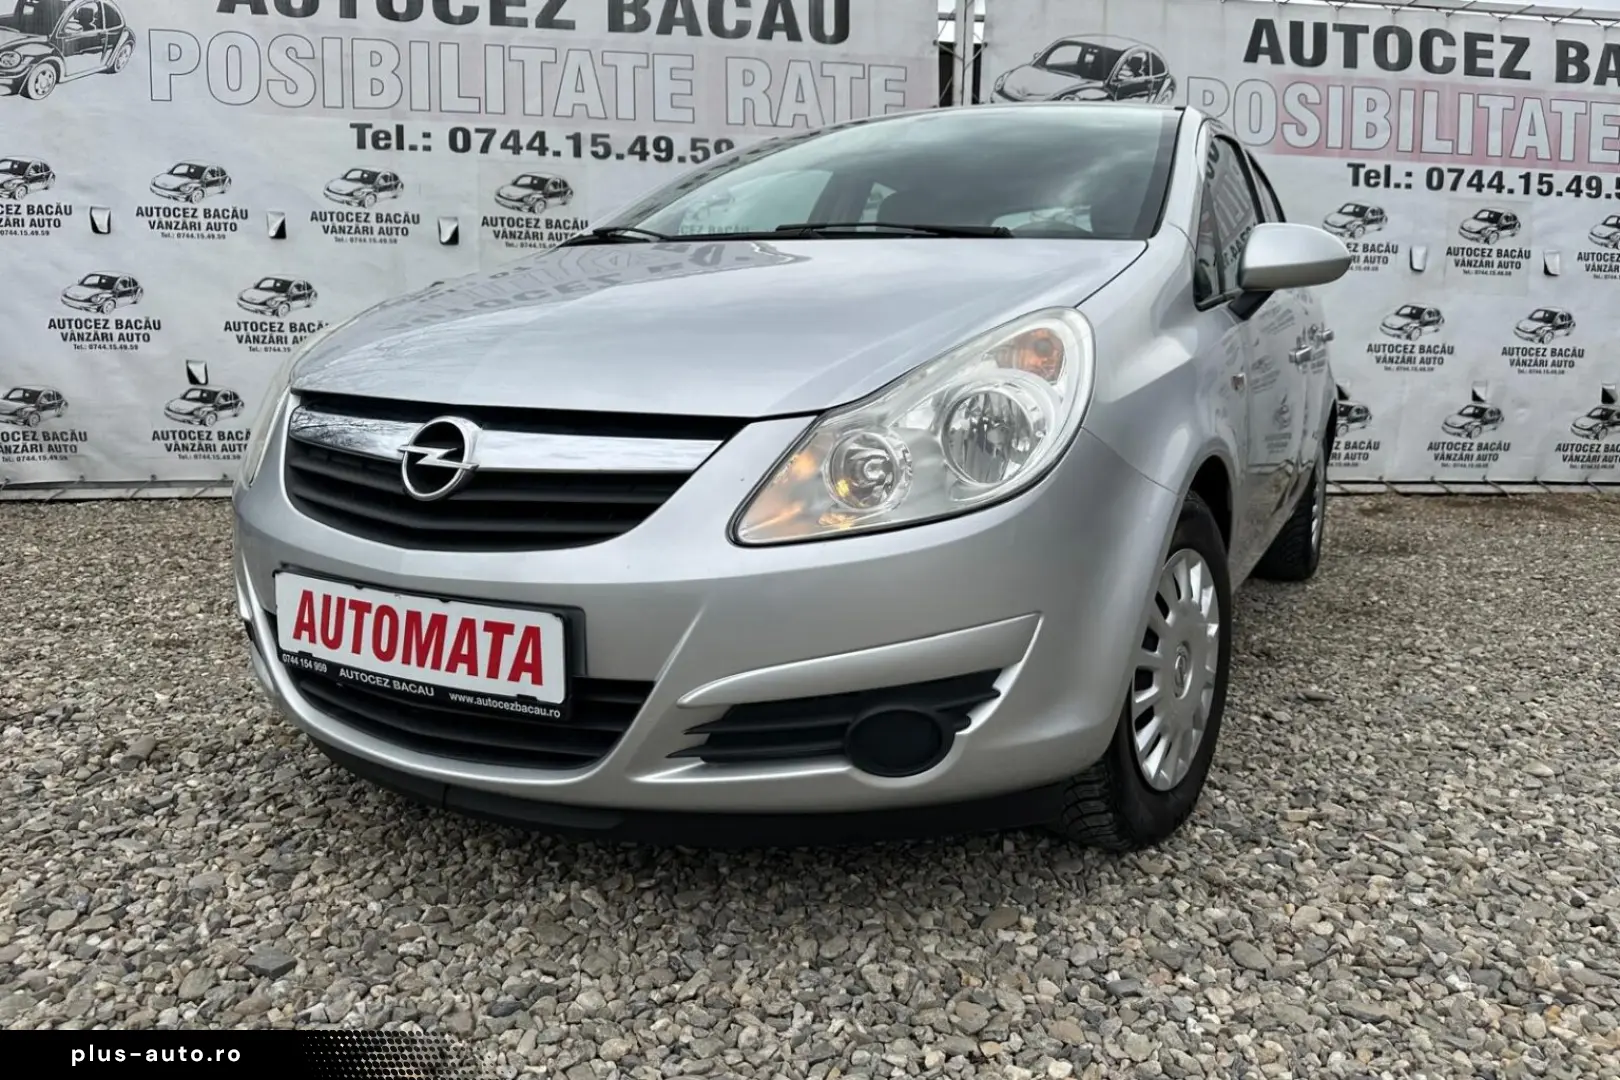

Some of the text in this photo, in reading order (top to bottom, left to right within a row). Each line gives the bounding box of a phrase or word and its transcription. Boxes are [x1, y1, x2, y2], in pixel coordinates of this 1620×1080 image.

[1243, 18, 1531, 81] AUTOCEZ
[148, 28, 695, 123] POSIBILITATE
[350, 123, 432, 153] Tel.:
[1347, 162, 1620, 201] Tel.: 0744.15.49.
[27, 202, 72, 216] BACĂU
[136, 206, 248, 220] AUTOCEZ BACĂU
[30, 218, 61, 228] AUTO
[310, 210, 420, 224] AUTOCEZ BACĂU
[481, 216, 588, 230] AUTOCEZ BACĂU
[148, 219, 237, 232] VÂNZĂRI AUTO
[322, 224, 409, 236] VÂNZĂRI AUTO
[493, 229, 543, 240] VÂNZĂRI
[1446, 247, 1493, 257] AUTOCEZ
[1364, 256, 1388, 265] AUTO
[1497, 261, 1521, 269] AUTO
[48, 317, 161, 330] AUTOCEZ BACĂU
[224, 321, 329, 333] AUTOCEZ BACĂ
[61, 330, 150, 342] VÂNZĂRI AUTO
[236, 333, 288, 344] VÂNZĂRI
[1367, 344, 1415, 354] AUTOCEZ
[1501, 347, 1547, 357] AUTOCEZ
[1419, 356, 1444, 365] AUTO
[1551, 360, 1575, 368] AUTO
[42, 429, 88, 442] BACĂU
[152, 430, 213, 441] AUTOCEZ
[48, 444, 77, 453] AUTO
[165, 441, 216, 452] VÂNZĂRI
[1427, 442, 1474, 451] AUTOCEZ
[1555, 443, 1601, 453] AUTOCEZ
[1344, 452, 1369, 460] AUTO
[1476, 453, 1499, 462] AUTO
[292, 588, 544, 687] AUTOMATA
[282, 653, 299, 666] 0744
[300, 658, 313, 670] 154
[339, 667, 435, 697] AUTOCEZ BACAU
[448, 692, 561, 718] www.autocezbacau.ro
